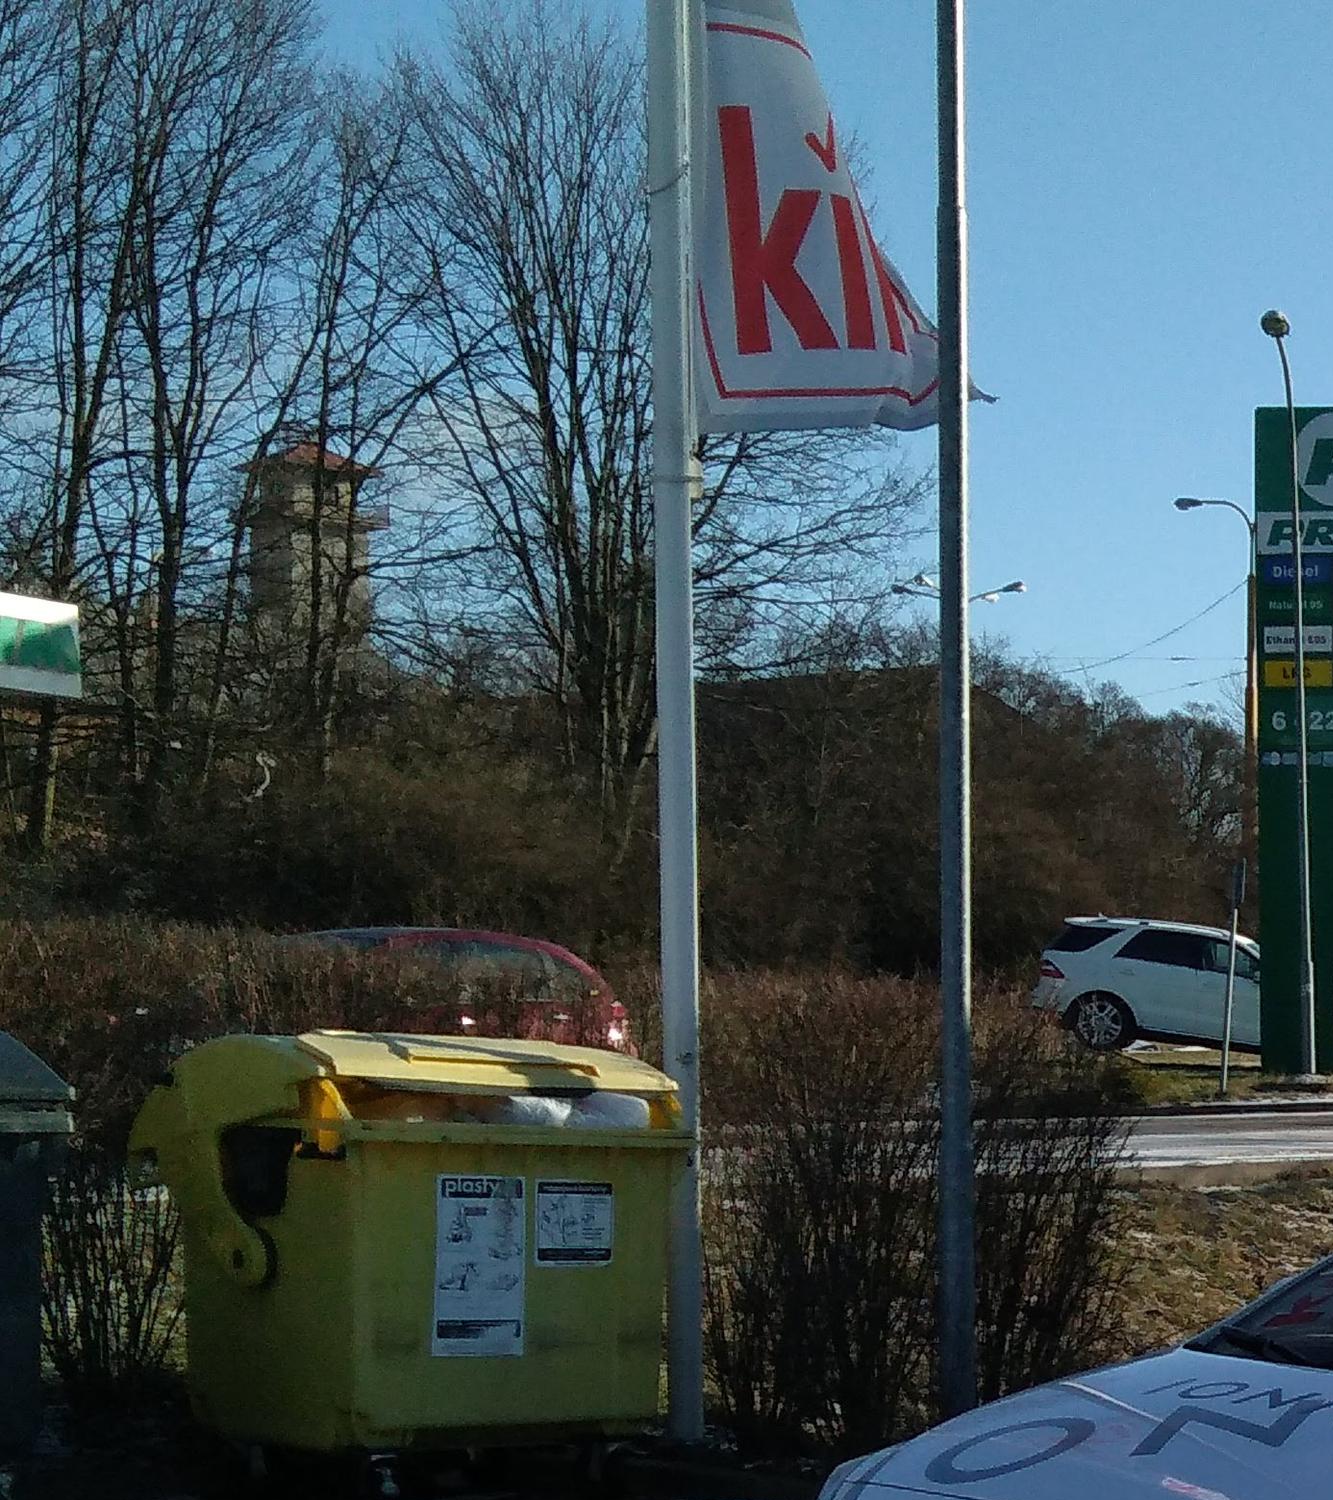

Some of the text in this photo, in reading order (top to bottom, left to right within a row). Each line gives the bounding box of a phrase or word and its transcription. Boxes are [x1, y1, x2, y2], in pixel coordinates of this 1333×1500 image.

[1272, 564, 1319, 579] Dieel
[1271, 711, 1287, 731] 6
[445, 1176, 500, 1198] plasty
